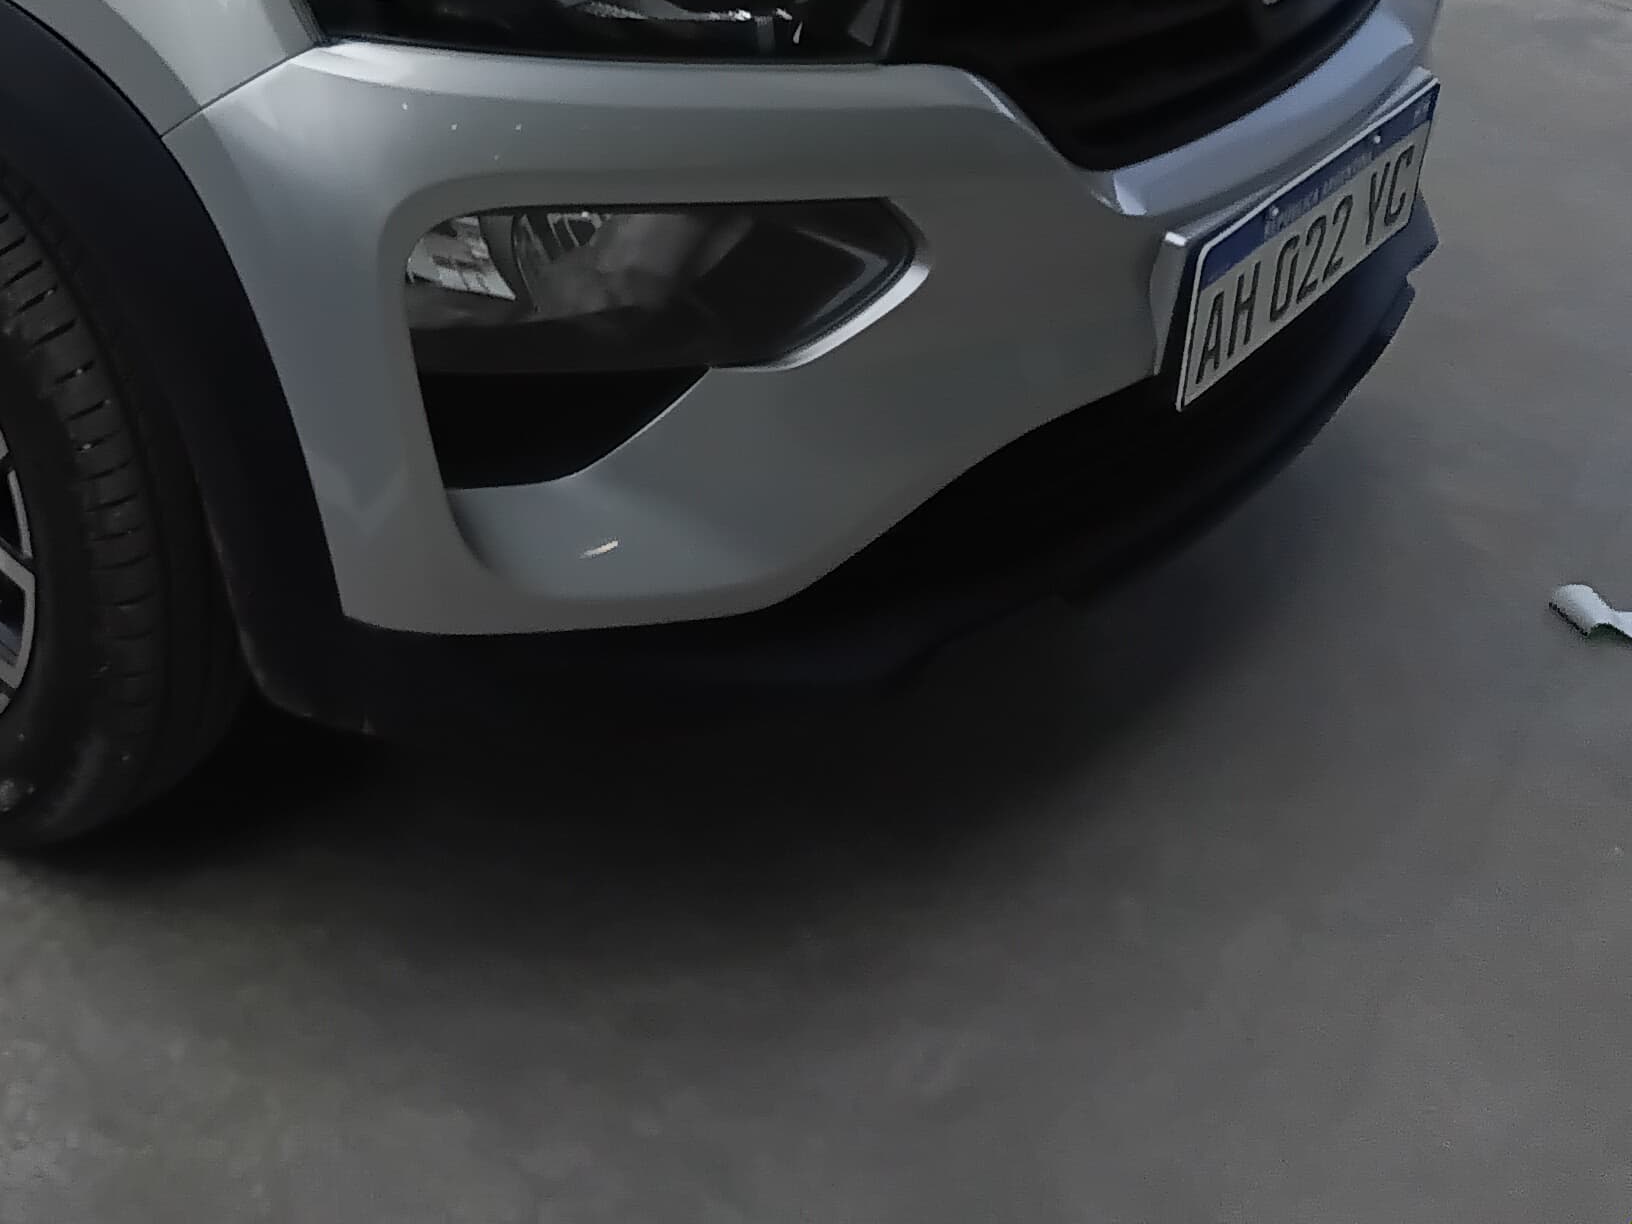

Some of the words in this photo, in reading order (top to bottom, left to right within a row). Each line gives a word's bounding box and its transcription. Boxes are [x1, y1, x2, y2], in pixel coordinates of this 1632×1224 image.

[1196, 261, 1261, 384] AH
[1269, 195, 1353, 322] 022
[1366, 144, 1414, 244] YC
